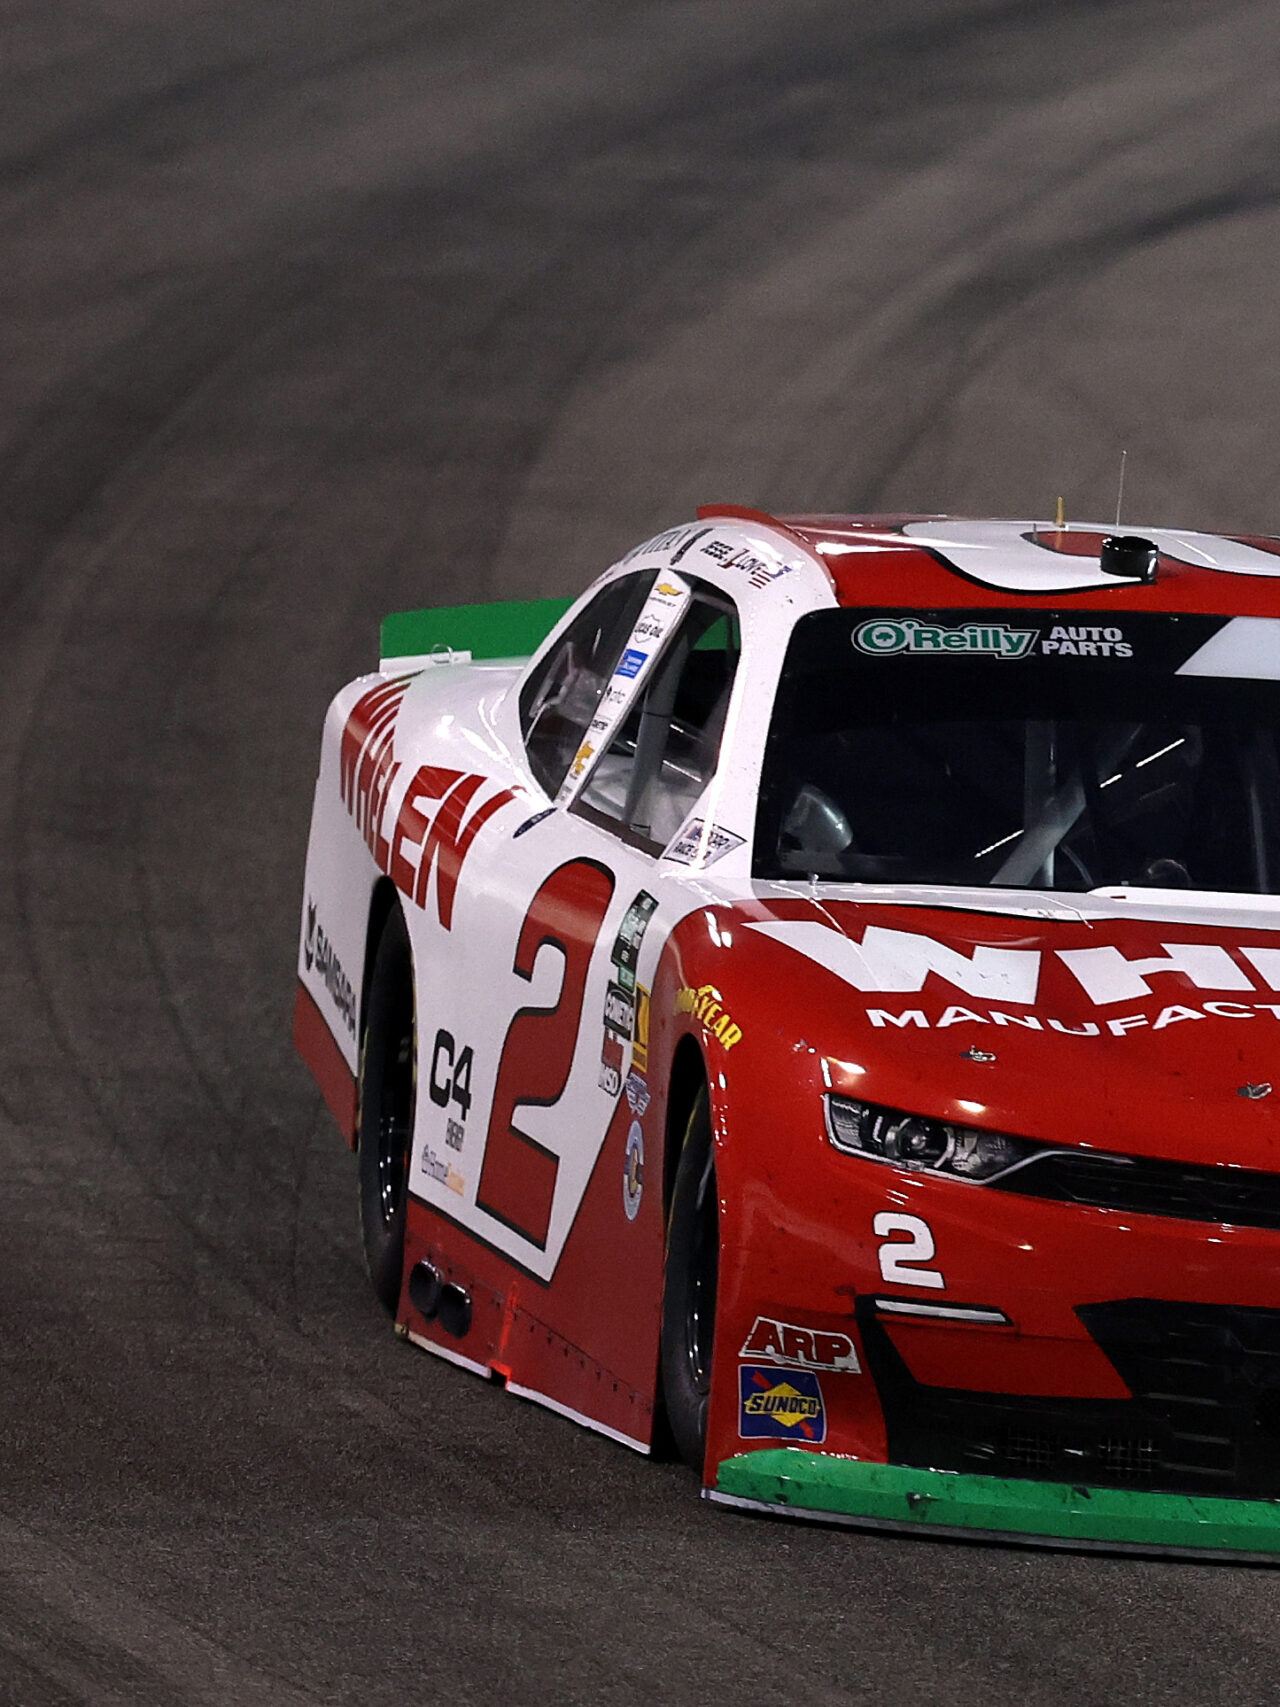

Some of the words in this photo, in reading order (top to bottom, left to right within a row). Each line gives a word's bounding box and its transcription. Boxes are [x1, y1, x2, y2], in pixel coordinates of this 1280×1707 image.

[860, 620, 1034, 656] O'Reilly
[1041, 640, 1133, 657] PARTS
[1050, 626, 1122, 642] AUTO
[341, 668, 526, 932] WHELEN
[430, 1028, 474, 1122] C4
[476, 856, 616, 1252] 2
[873, 1212, 945, 1289] 2
[745, 1320, 855, 1368] ARP
[749, 1395, 817, 1415] SUNOCO
